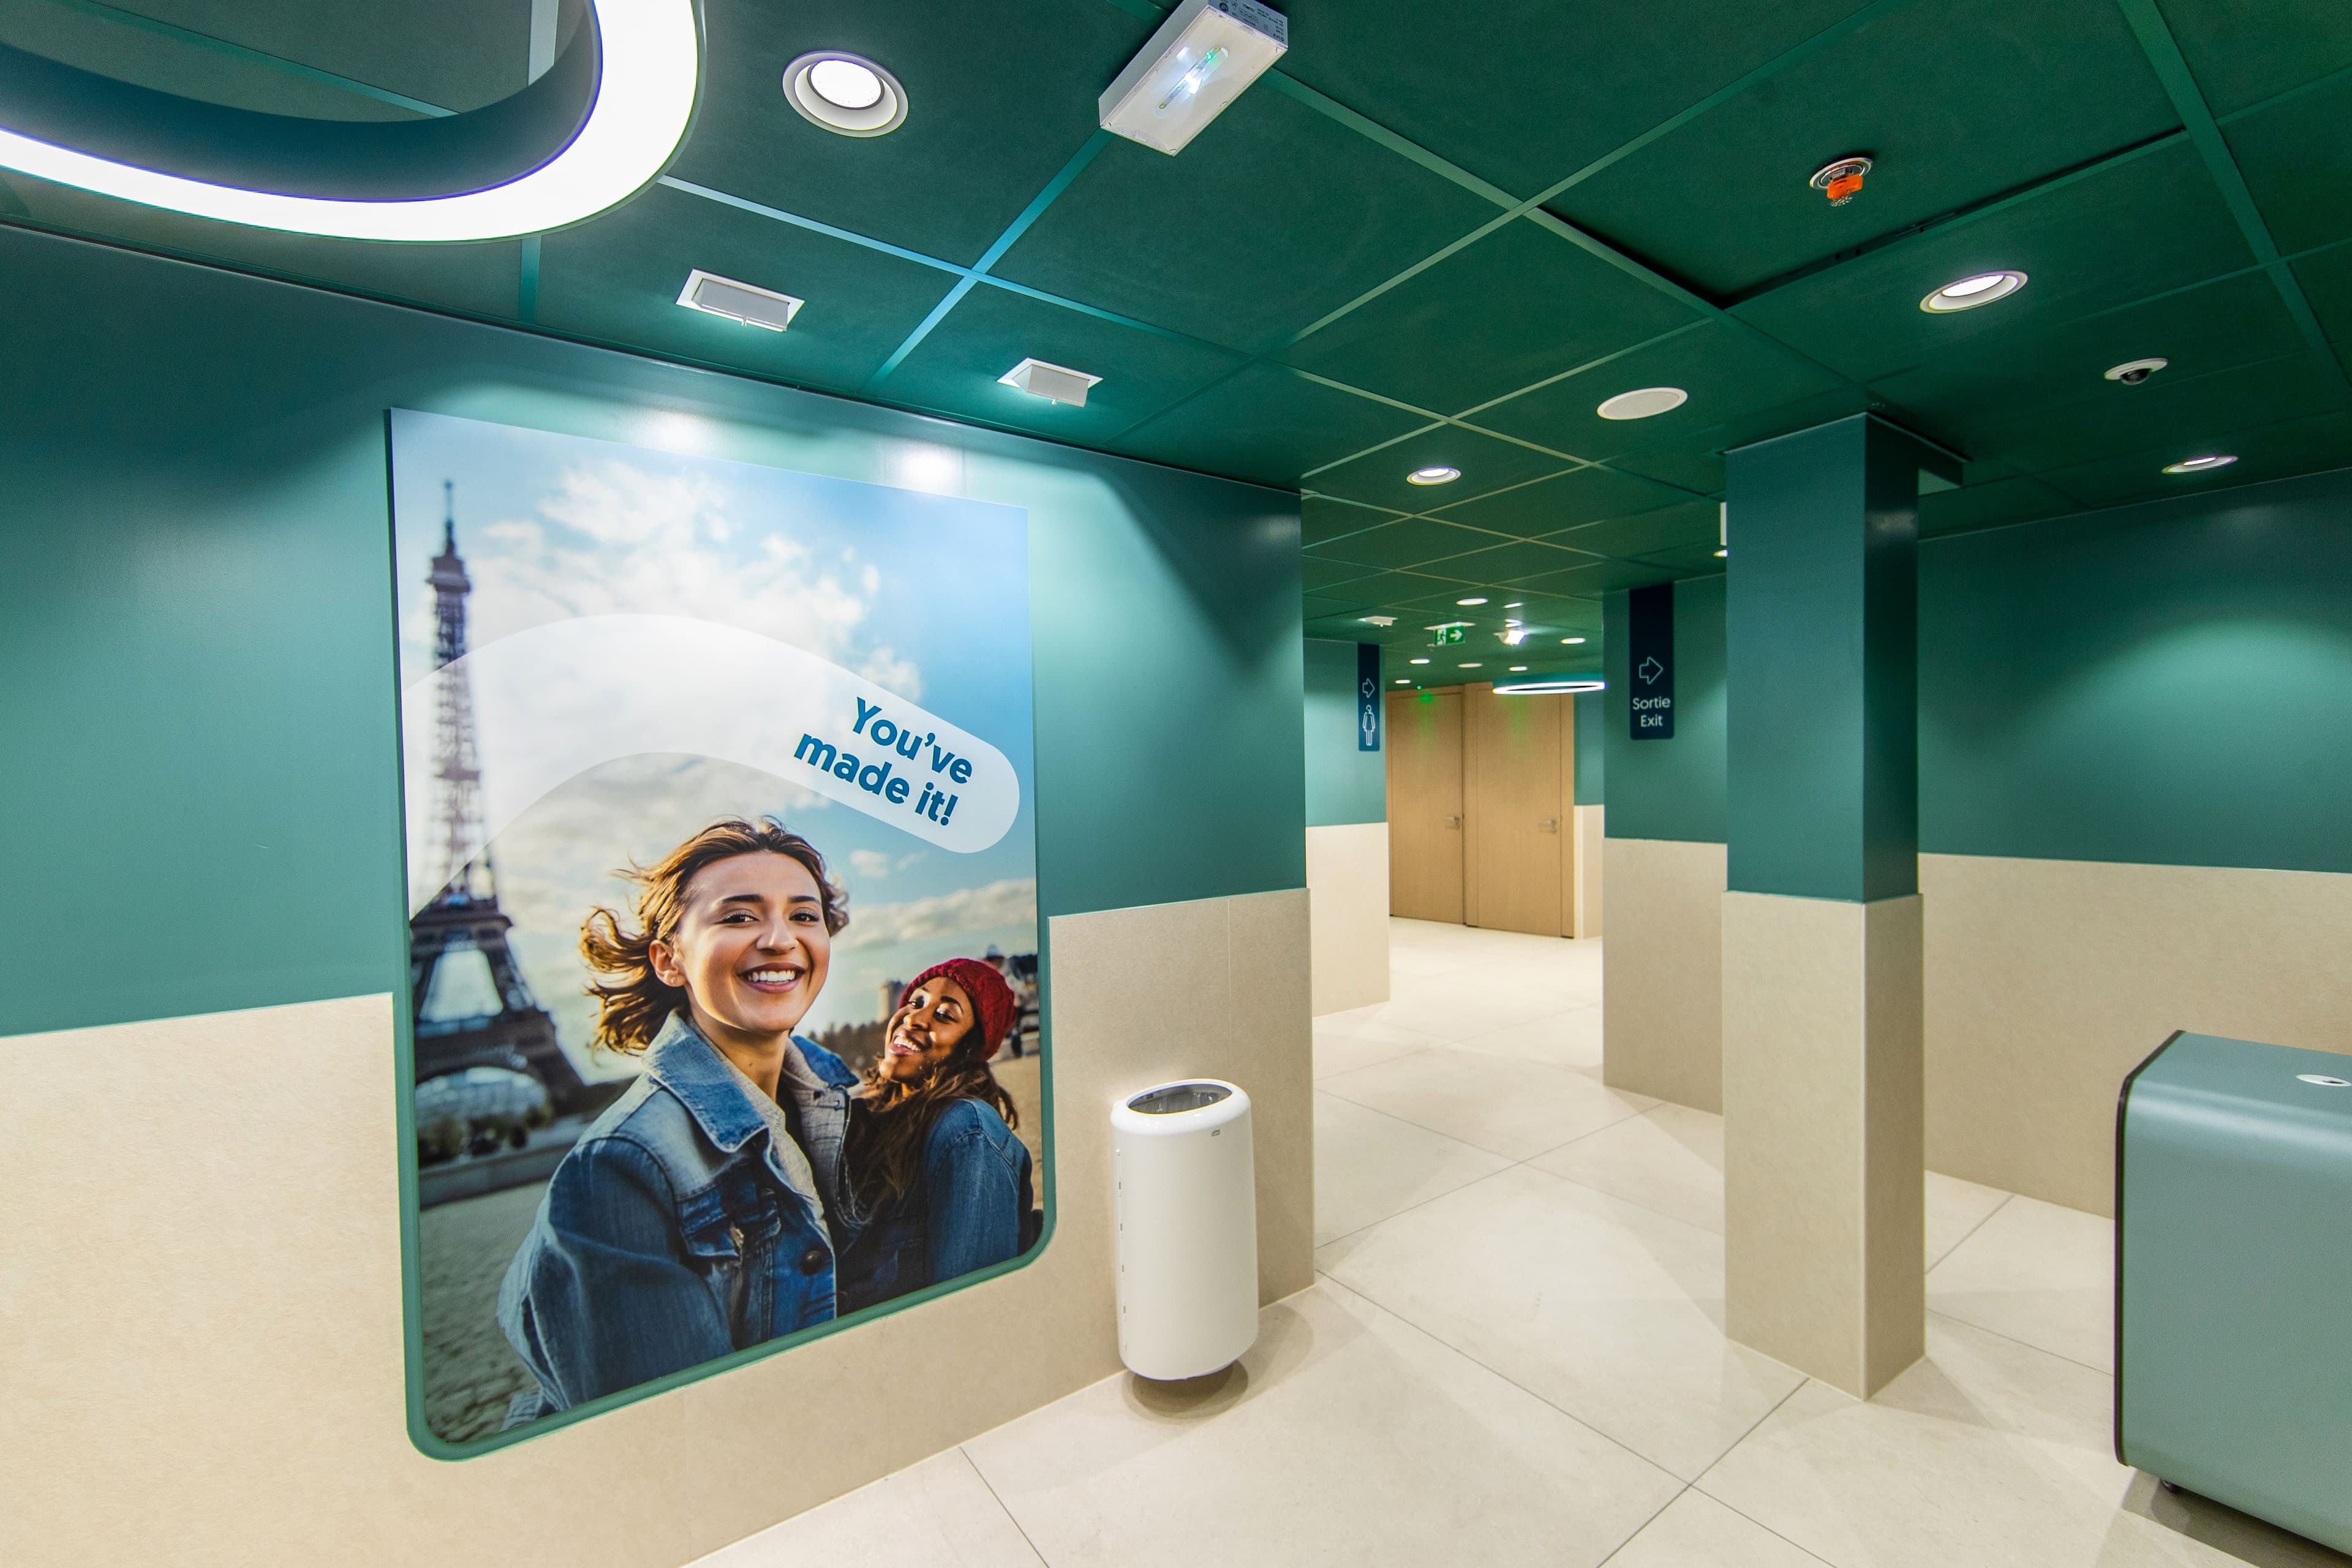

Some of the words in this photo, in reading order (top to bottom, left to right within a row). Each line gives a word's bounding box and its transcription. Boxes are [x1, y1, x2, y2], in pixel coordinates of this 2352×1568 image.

[1632, 696, 1671, 710] Sortie
[1640, 714, 1663, 727] Exit
[852, 696, 973, 784] You’ve
[793, 733, 910, 804] made
[914, 782, 959, 826] it!
